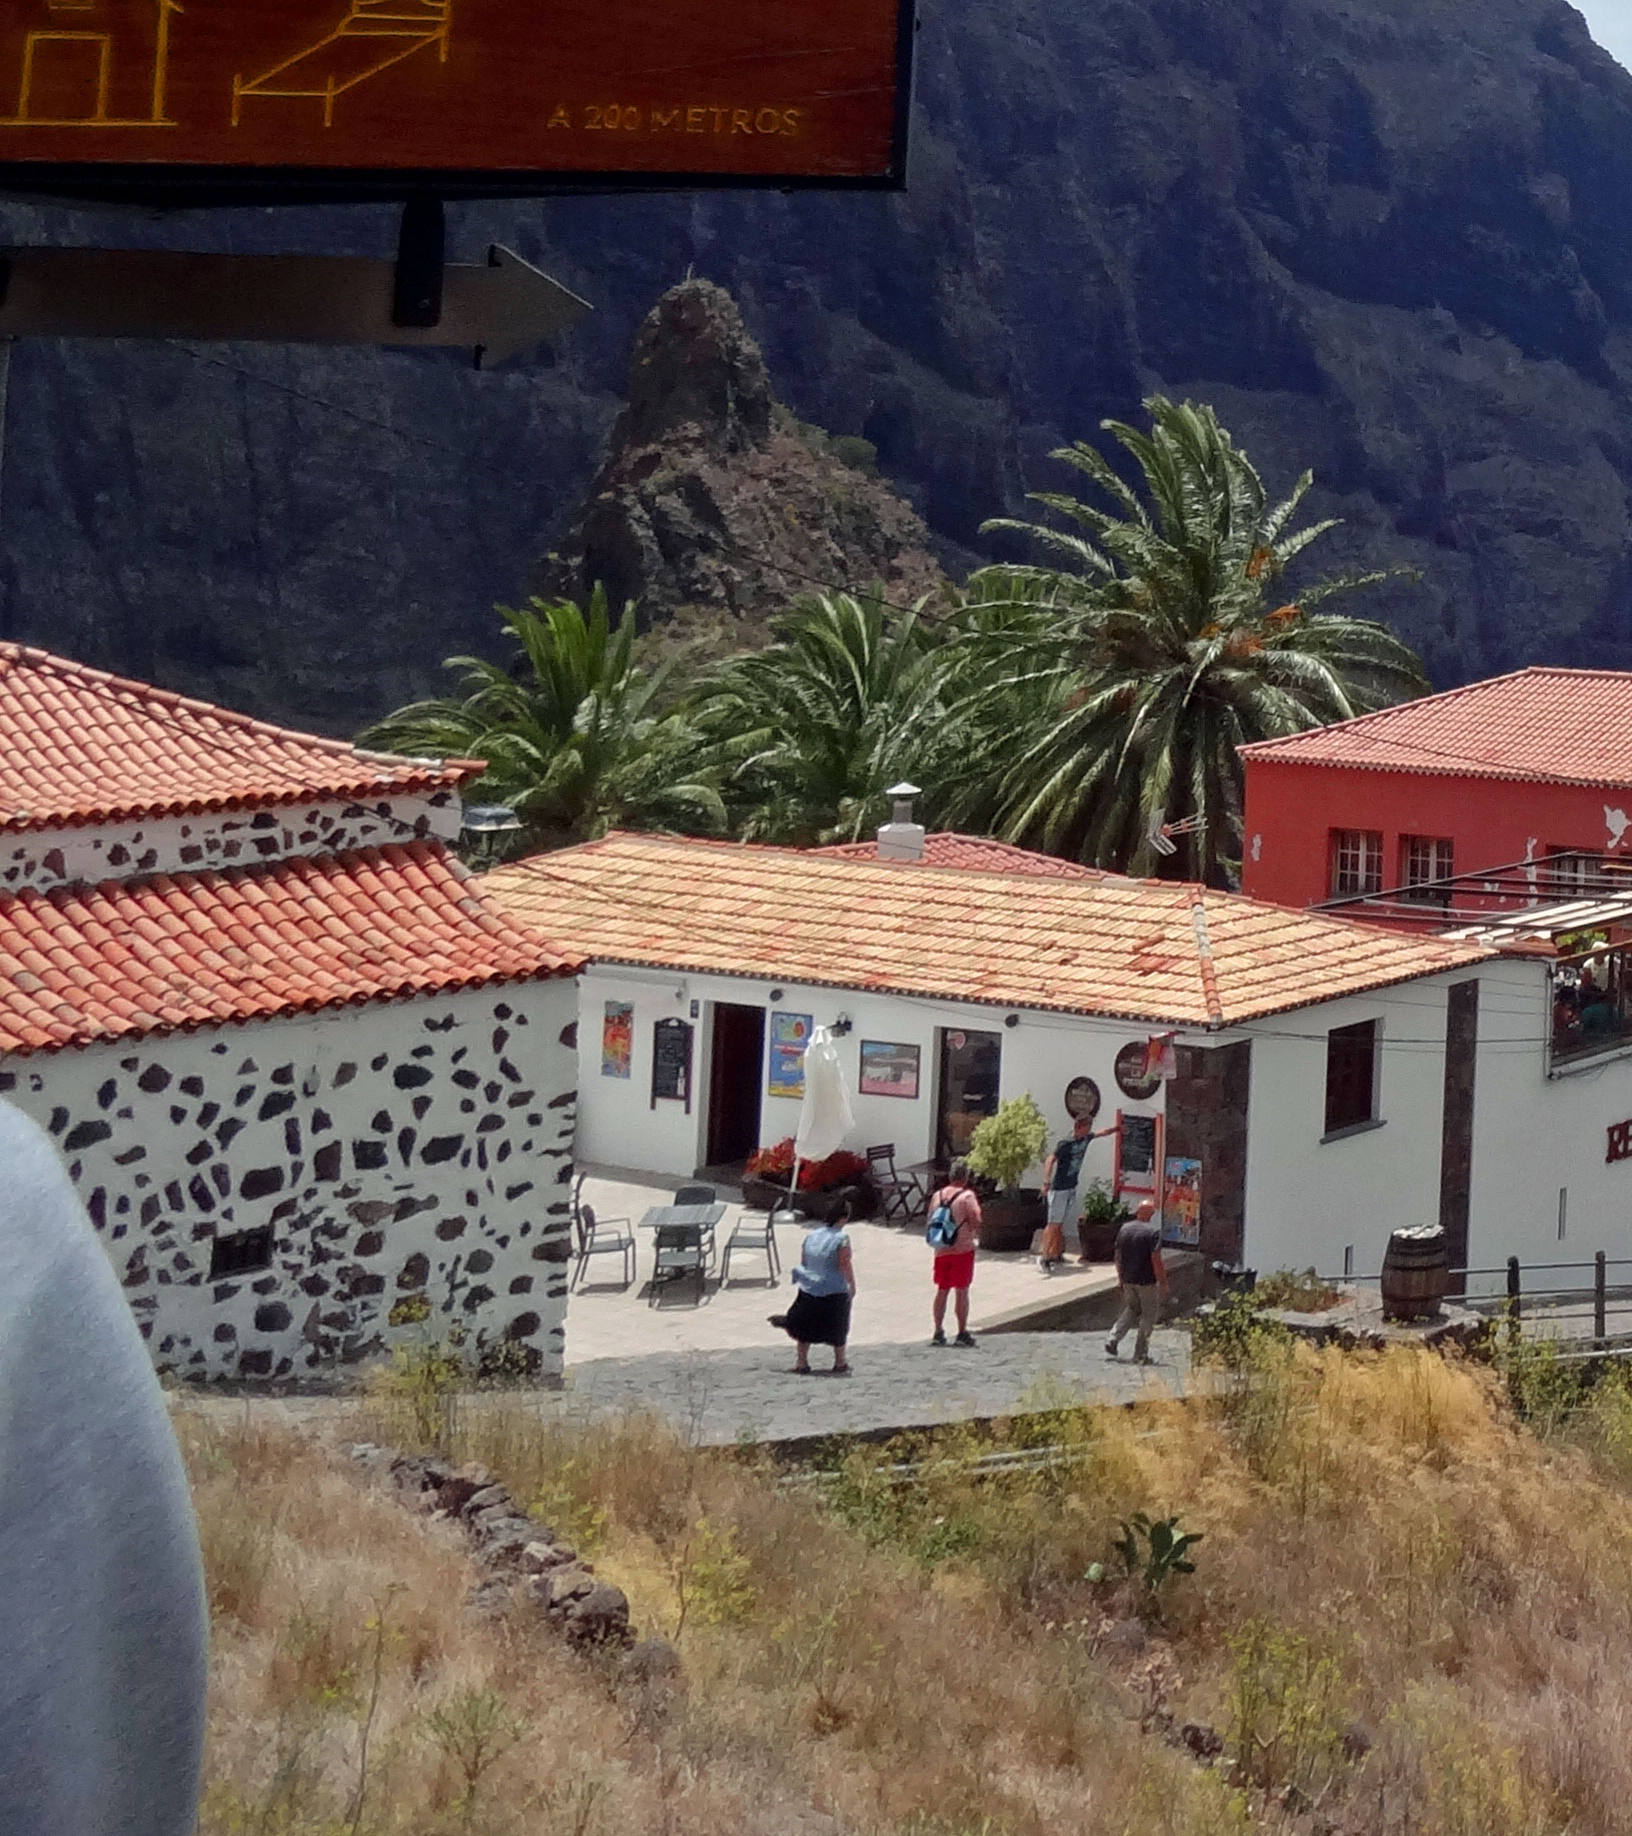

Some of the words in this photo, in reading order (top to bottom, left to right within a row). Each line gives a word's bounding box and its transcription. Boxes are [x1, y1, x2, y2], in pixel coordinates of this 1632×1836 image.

[547, 103, 570, 129] A
[584, 103, 640, 131] 200
[651, 105, 802, 136] METROS
